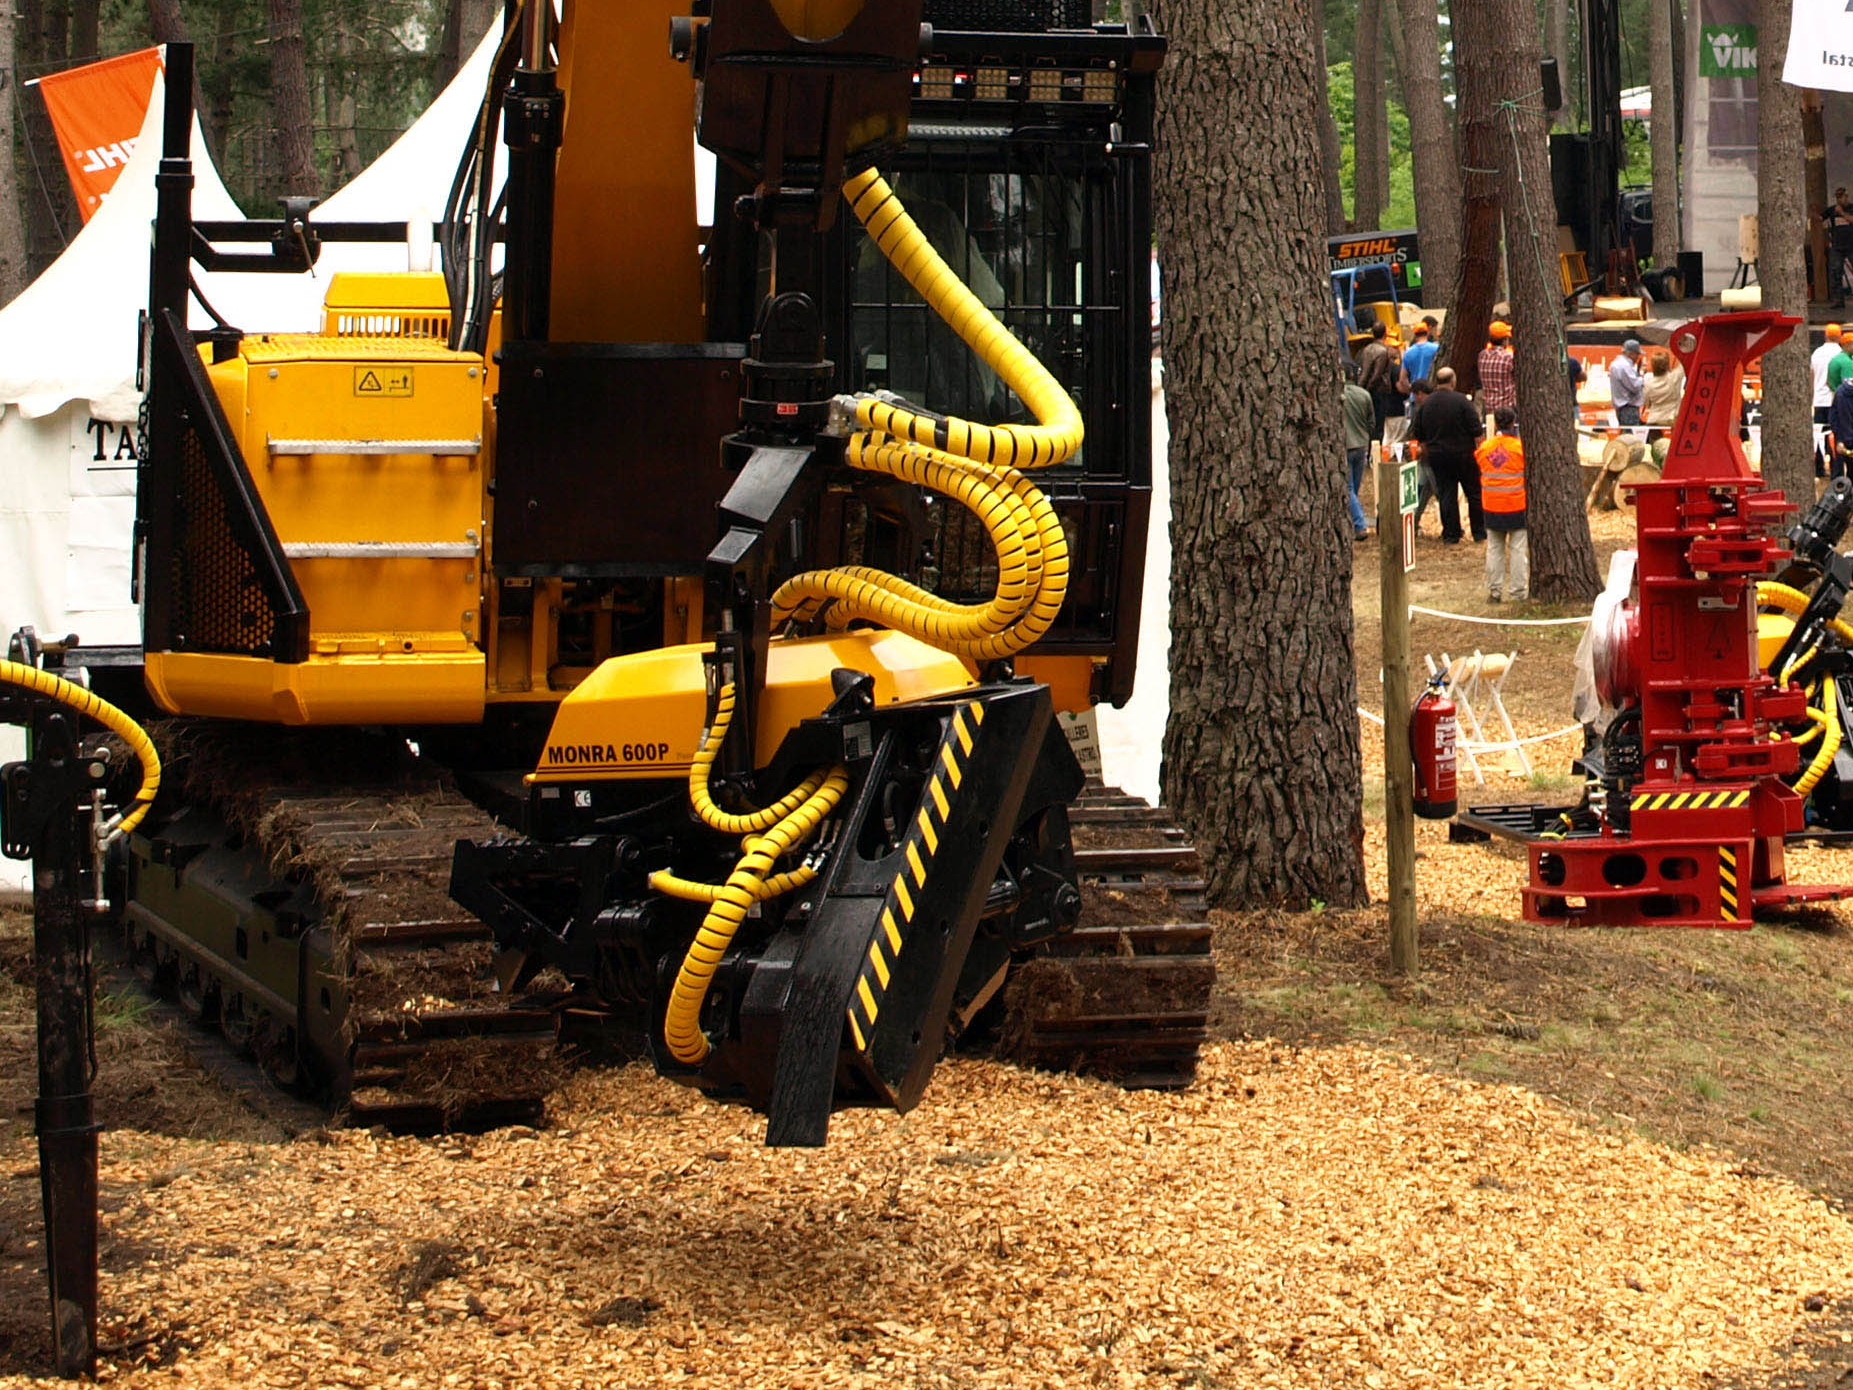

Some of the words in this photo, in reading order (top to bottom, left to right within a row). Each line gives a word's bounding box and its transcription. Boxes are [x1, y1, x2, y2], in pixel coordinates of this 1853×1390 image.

[1338, 238, 1396, 259] STIHL
[1684, 370, 1716, 450] MONRA
[548, 744, 617, 763] MONRA
[622, 743, 669, 761] 600P
